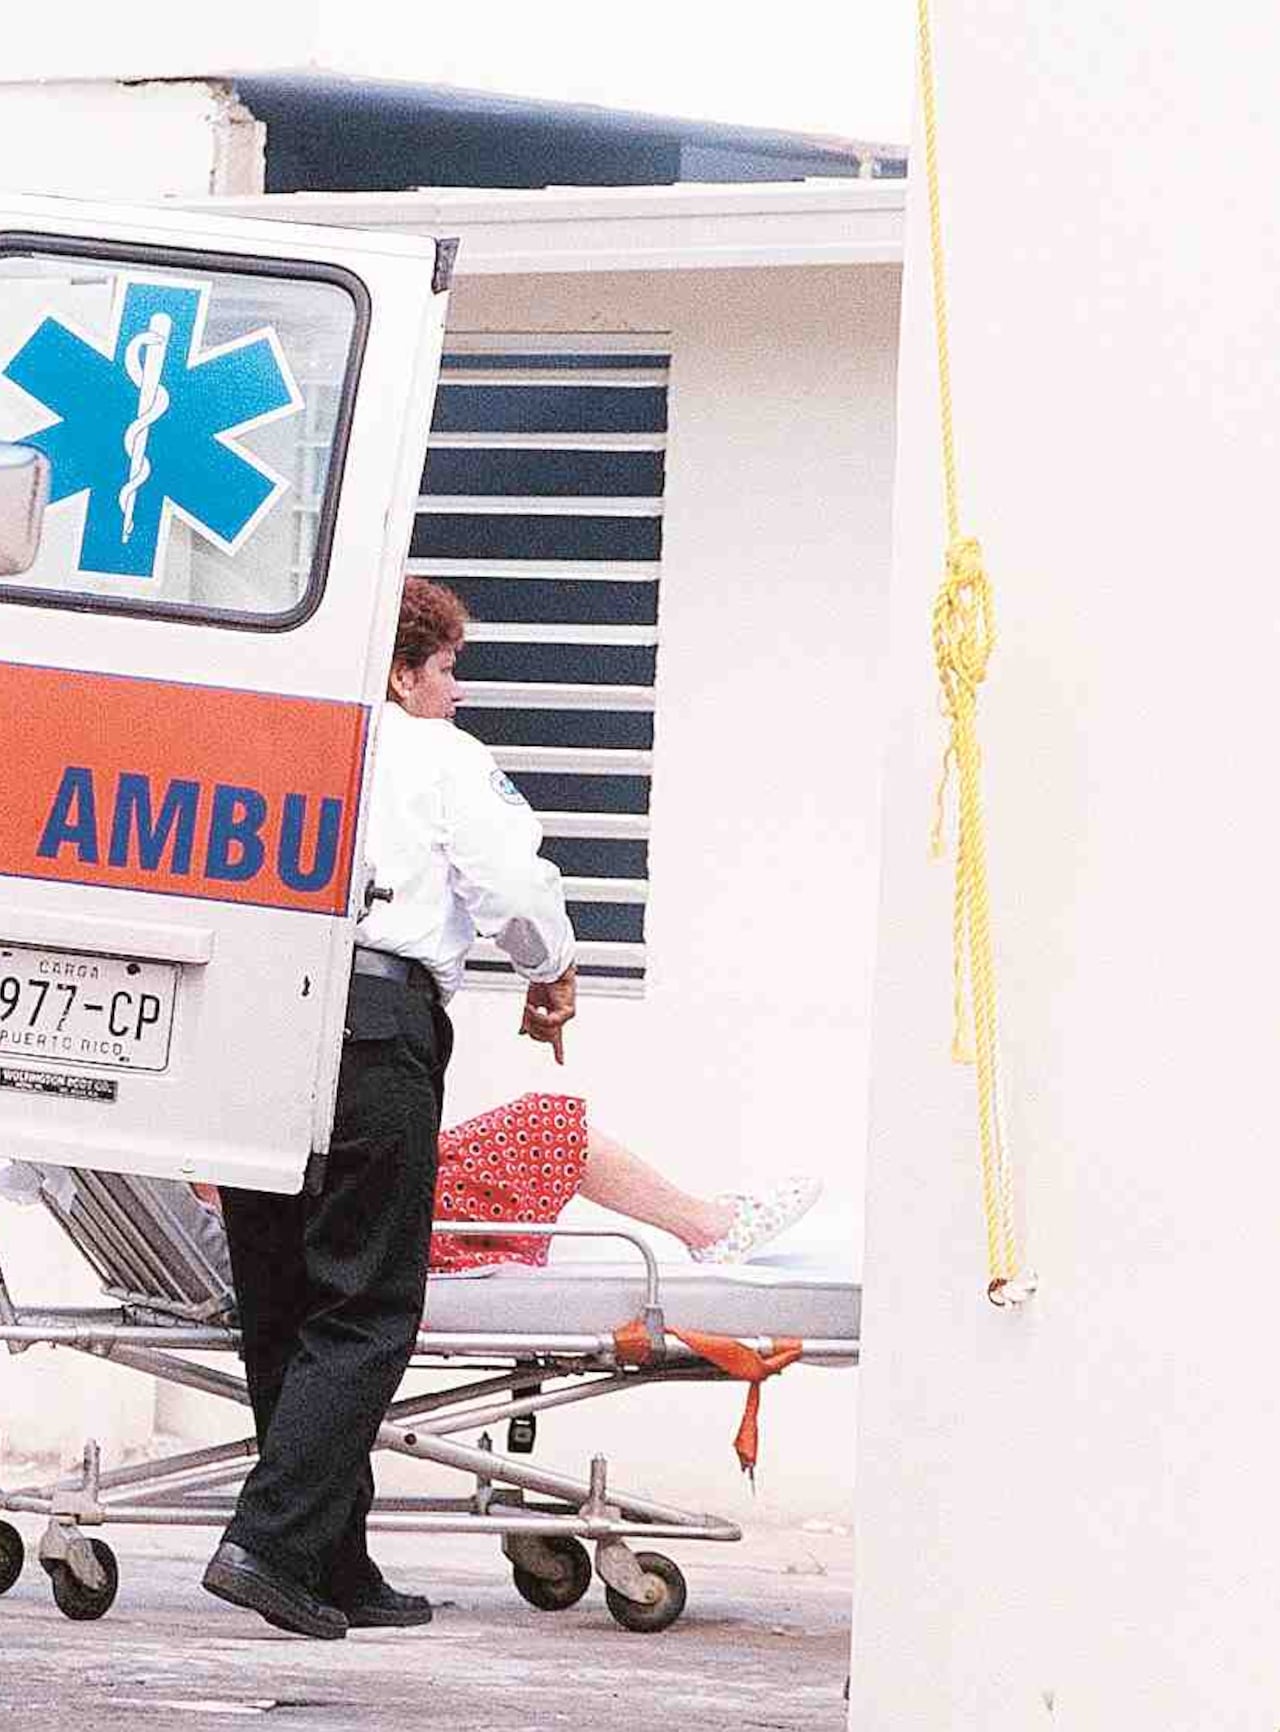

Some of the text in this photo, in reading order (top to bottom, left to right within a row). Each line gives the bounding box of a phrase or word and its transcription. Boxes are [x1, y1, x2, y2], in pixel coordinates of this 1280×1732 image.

[36, 766, 343, 892] AMBU
[39, 961, 99, 979] CARGA
[0, 1029, 123, 1056] PUERTO RICO
